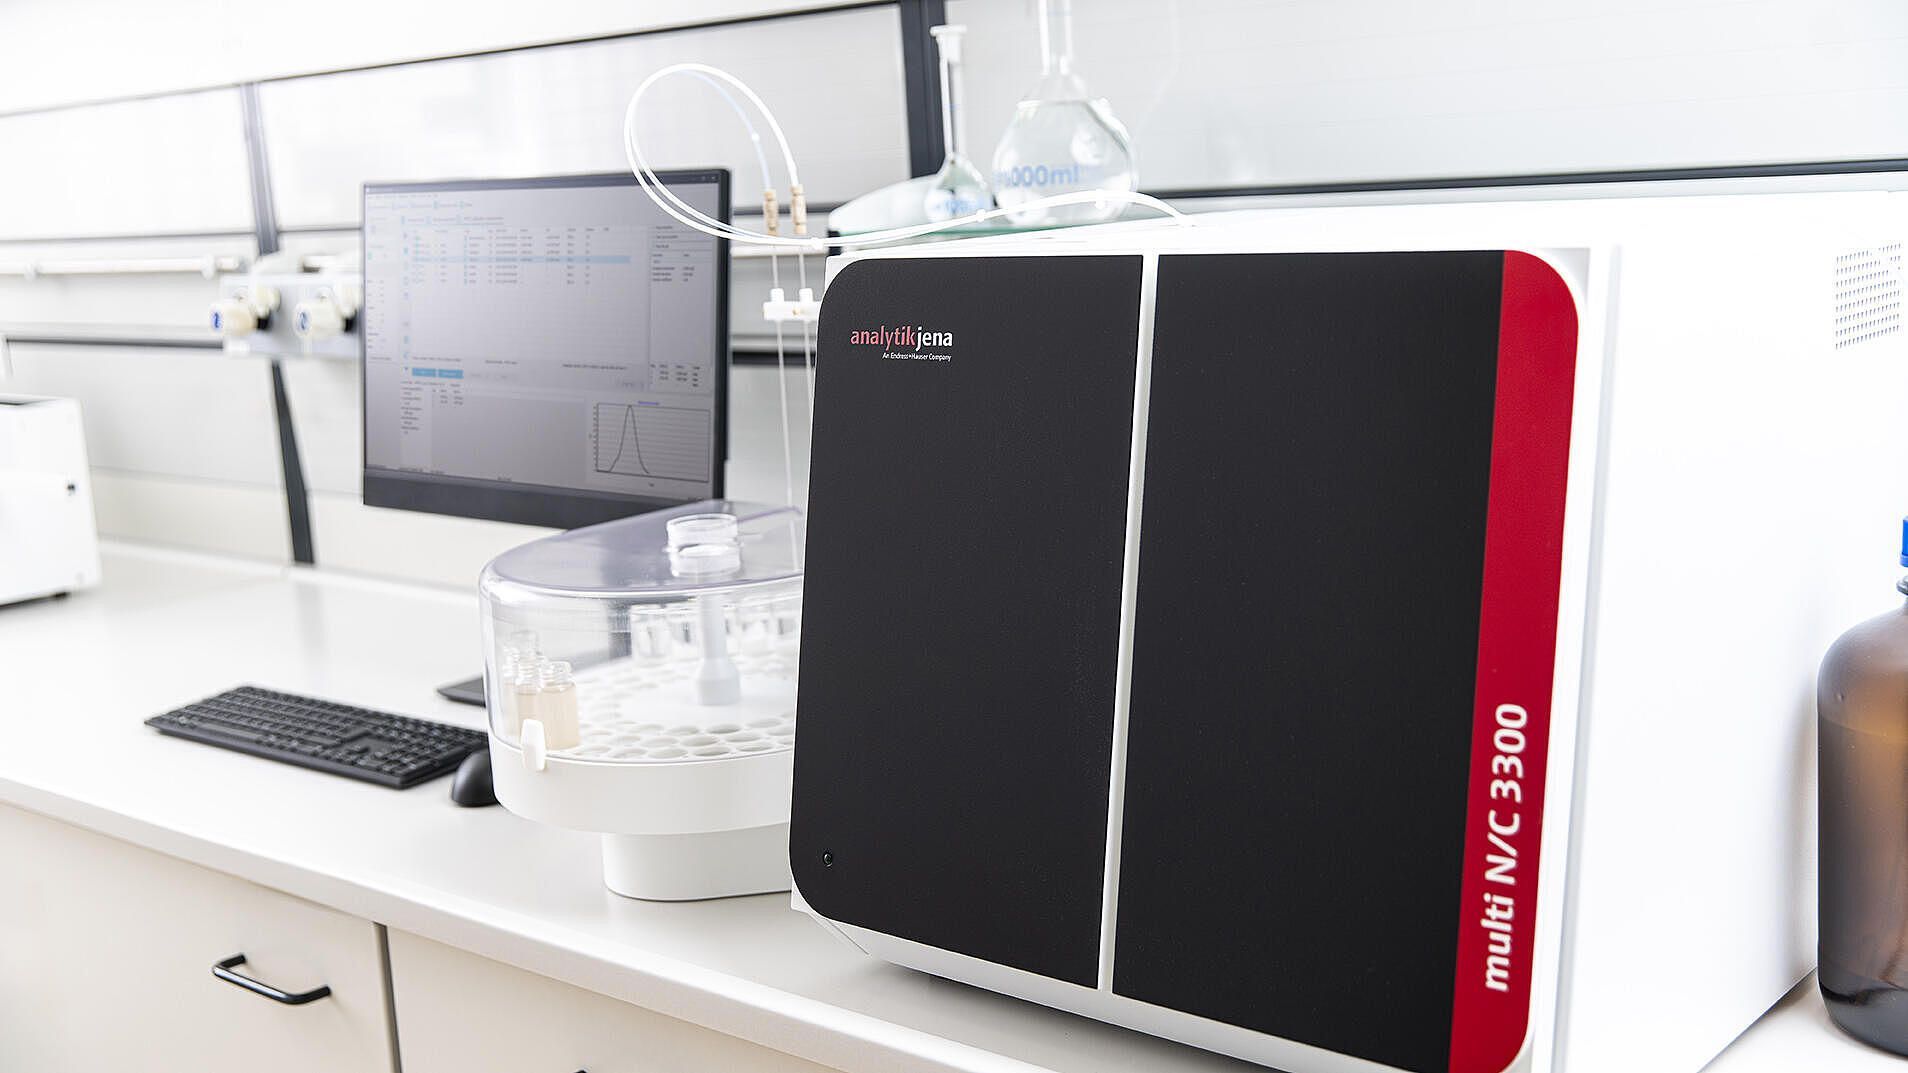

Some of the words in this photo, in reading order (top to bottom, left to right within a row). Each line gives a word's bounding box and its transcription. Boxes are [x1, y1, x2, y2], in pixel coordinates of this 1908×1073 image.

[850, 325, 953, 352] analytikjena
[928, 353, 952, 362] Company
[1490, 703, 1528, 803] 3300
[1484, 809, 1521, 885] N/C
[1480, 893, 1514, 993] multi
